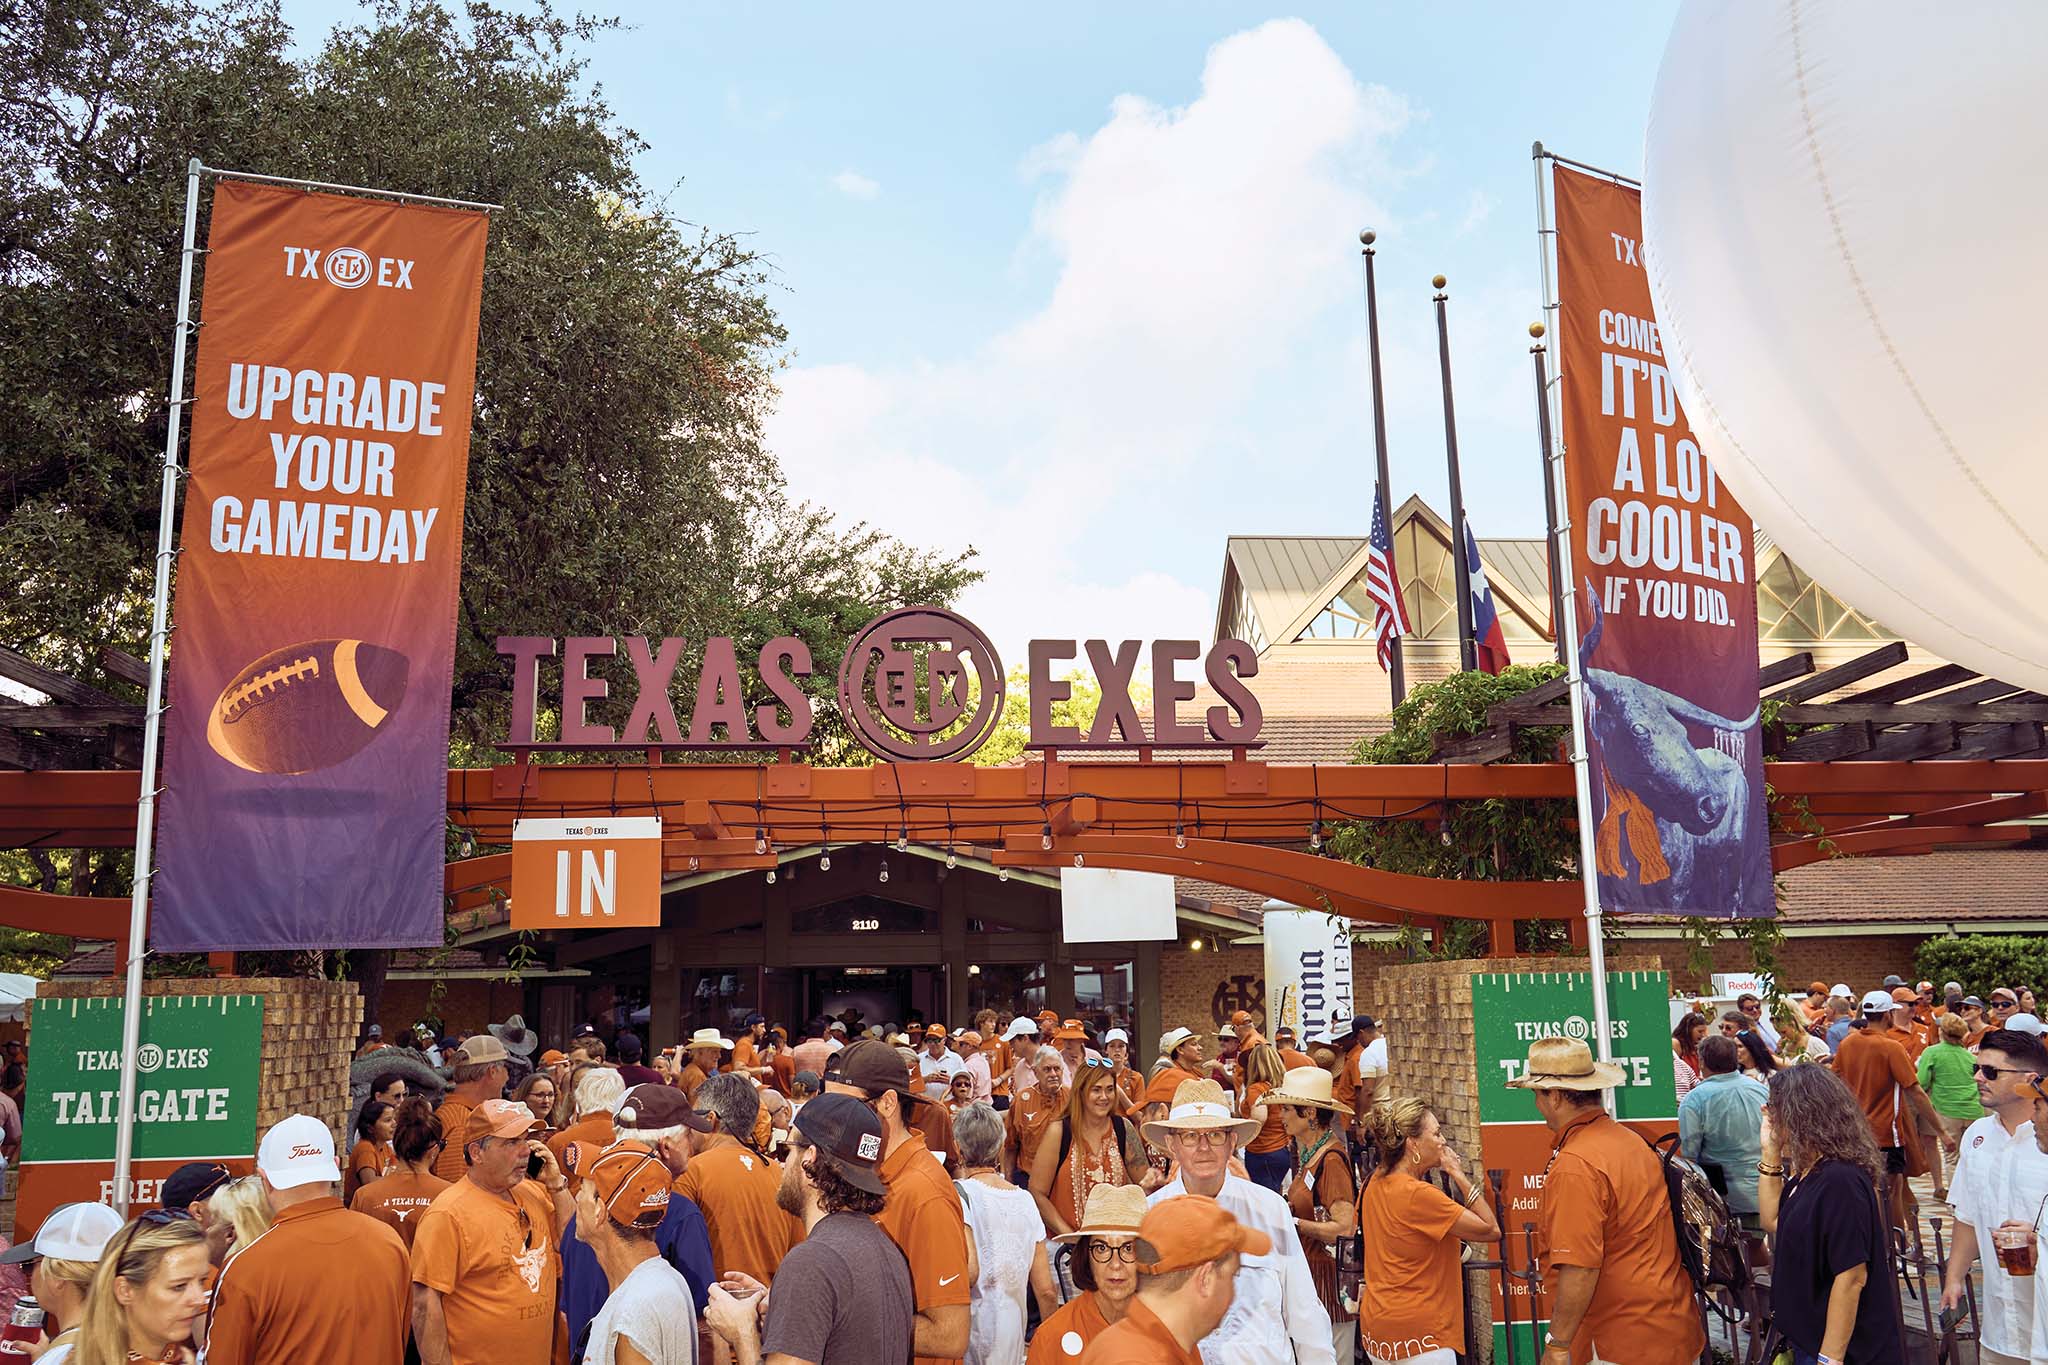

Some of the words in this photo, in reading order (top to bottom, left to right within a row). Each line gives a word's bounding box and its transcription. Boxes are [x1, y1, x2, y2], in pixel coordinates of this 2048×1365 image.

[284, 246, 321, 280] TX
[377, 257, 415, 290] EX
[1611, 232, 1638, 267] TX
[1599, 308, 1663, 357] COME
[226, 362, 446, 436] UPGRADE
[1601, 351, 1677, 427] IT'D
[269, 432, 396, 497] YOUR
[1613, 426, 1645, 493] A
[209, 495, 440, 564] GAMEDAY
[1586, 496, 1745, 584] COOLER
[1603, 575, 1630, 614] IF
[1635, 578, 1688, 621] YOU
[1694, 584, 1736, 627] DID.
[496, 636, 814, 744] TEXAS
[1028, 638, 1263, 744] EXES
[565, 827, 584, 836] TEXAS
[593, 827, 609, 835] EXES
[555, 849, 617, 918] IN
[852, 919, 879, 931] 2110
[1515, 1020, 1562, 1040] TEXAS
[77, 1050, 124, 1071] TEXA
[165, 1048, 209, 1069] EXES
[288, 1143, 322, 1160] Texas
[391, 1197, 415, 1206] TEXAS
[415, 1197, 431, 1206] GIRL
[1512, 1196, 1541, 1211] Addi
